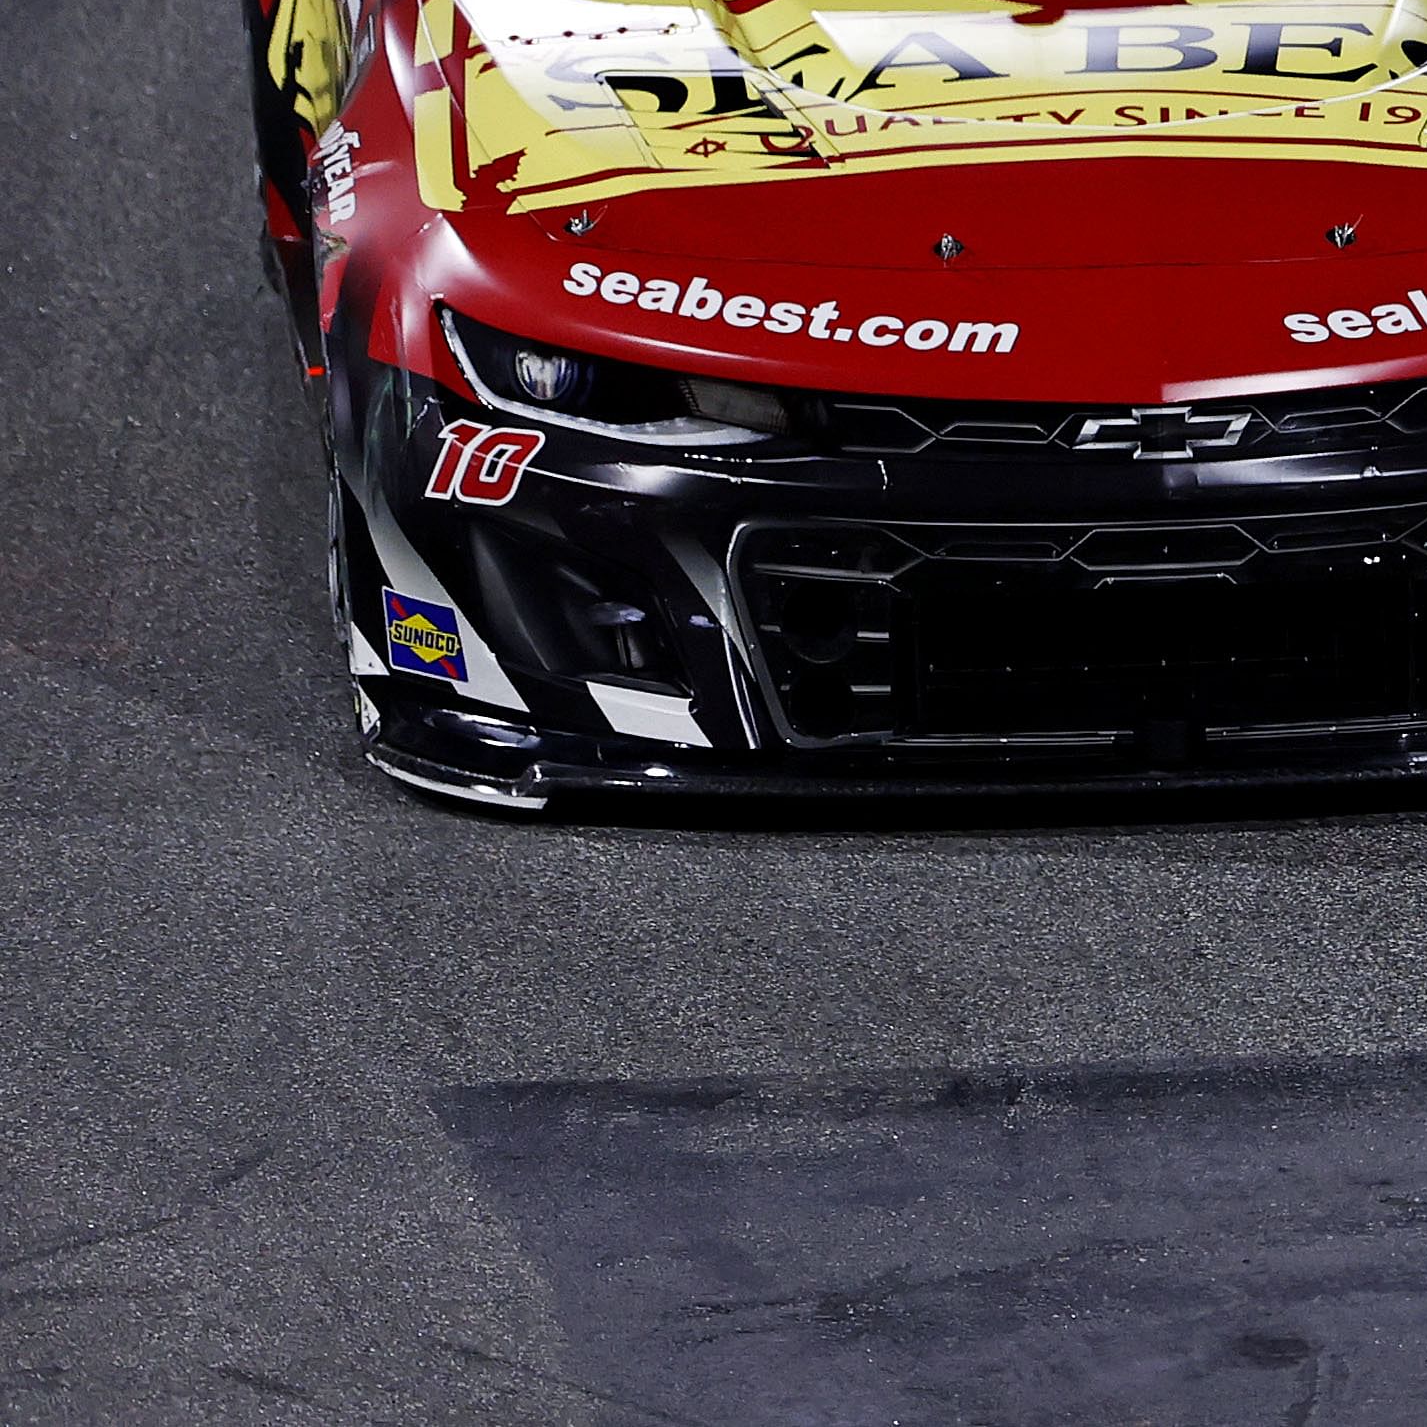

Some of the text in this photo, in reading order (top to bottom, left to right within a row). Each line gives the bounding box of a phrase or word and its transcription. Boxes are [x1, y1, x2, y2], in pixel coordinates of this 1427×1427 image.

[562, 261, 1021, 354] seabest.com
[423, 418, 546, 507] 10
[392, 621, 458, 655] SUNOCO
